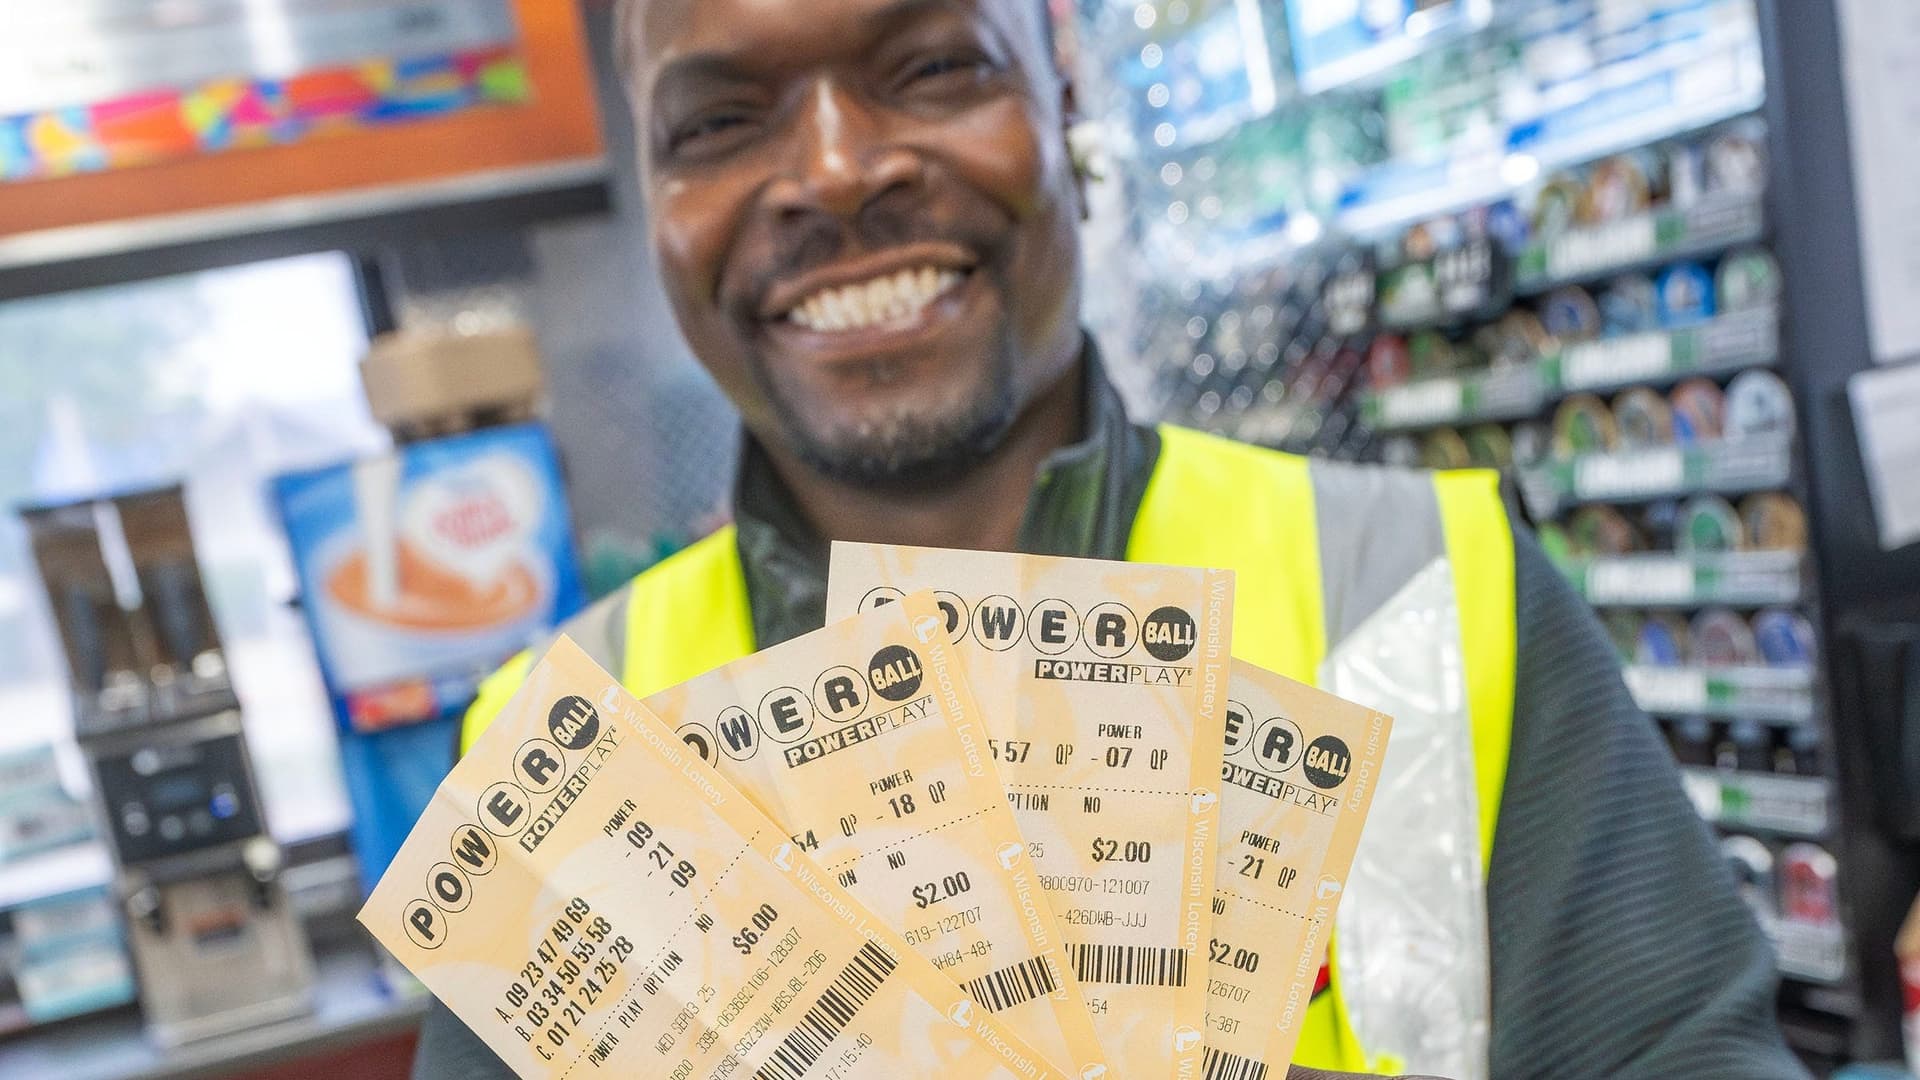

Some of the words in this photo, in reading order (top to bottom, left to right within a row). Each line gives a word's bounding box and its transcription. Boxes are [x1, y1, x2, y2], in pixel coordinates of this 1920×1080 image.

[1206, 579, 1228, 657] Wisconsin
[928, 644, 964, 720] Wisconsin
[955, 722, 985, 778] Lottery
[1199, 663, 1221, 720] Lottery
[624, 706, 683, 766] Wisconsin
[681, 761, 727, 806] Lottery
[1005, 741, 1031, 763] 57
[1056, 744, 1073, 765] QP
[1105, 746, 1133, 768] 07
[1150, 749, 1168, 770] QP
[1098, 723, 1143, 740] POWER
[1366, 712, 1384, 756] onsin
[869, 769, 914, 796] POWER
[1084, 796, 1101, 814] NO
[1347, 759, 1376, 813] Lottery
[603, 799, 637, 838] POWER
[626, 821, 653, 849] 09
[791, 830, 819, 853] 54
[840, 813, 857, 837] QP
[888, 793, 916, 819] 18
[928, 780, 946, 804] QP
[1240, 830, 1281, 854] POWER
[648, 841, 674, 870] 21
[670, 860, 697, 888] 09
[886, 850, 906, 870] NO
[1029, 842, 1044, 858] 25
[1092, 837, 1151, 863] $2.00
[1189, 820, 1209, 897] Wisconsin
[1238, 855, 1265, 879] 21
[1277, 867, 1297, 889] QP
[796, 864, 857, 925] Wisconsin
[912, 871, 971, 909] $2.00
[1012, 871, 1048, 947] Wisconsin
[733, 903, 779, 955] $6.00
[1186, 902, 1204, 956] Lottery
[495, 1007, 514, 1024] A.
[505, 982, 529, 1008] 09
[520, 961, 544, 988] 23
[536, 938, 558, 966] 47
[551, 918, 574, 945] 49
[564, 897, 590, 924] 69
[515, 1025, 534, 1042] B.
[526, 1001, 550, 1028] 03
[541, 979, 566, 1006] 34
[555, 958, 581, 985] 50
[570, 937, 596, 964] 55
[585, 916, 612, 943] 58
[1208, 938, 1259, 973] $2.00
[536, 1045, 554, 1061] C.
[546, 1021, 571, 1047] 01
[562, 1000, 586, 1026] 21
[578, 978, 603, 1005] 24
[594, 956, 617, 984] 25
[608, 935, 634, 963] 28
[588, 1032, 620, 1068] POWER
[618, 999, 644, 1029] PLAY
[642, 950, 684, 996] OPTION
[694, 913, 714, 934] NO
[1276, 982, 1306, 1033] Lottery
[653, 1033, 675, 1056] WED
[670, 1001, 700, 1035] SEP03
[696, 983, 717, 1003] 25
[975, 1020, 1037, 1077] Wisconsin
